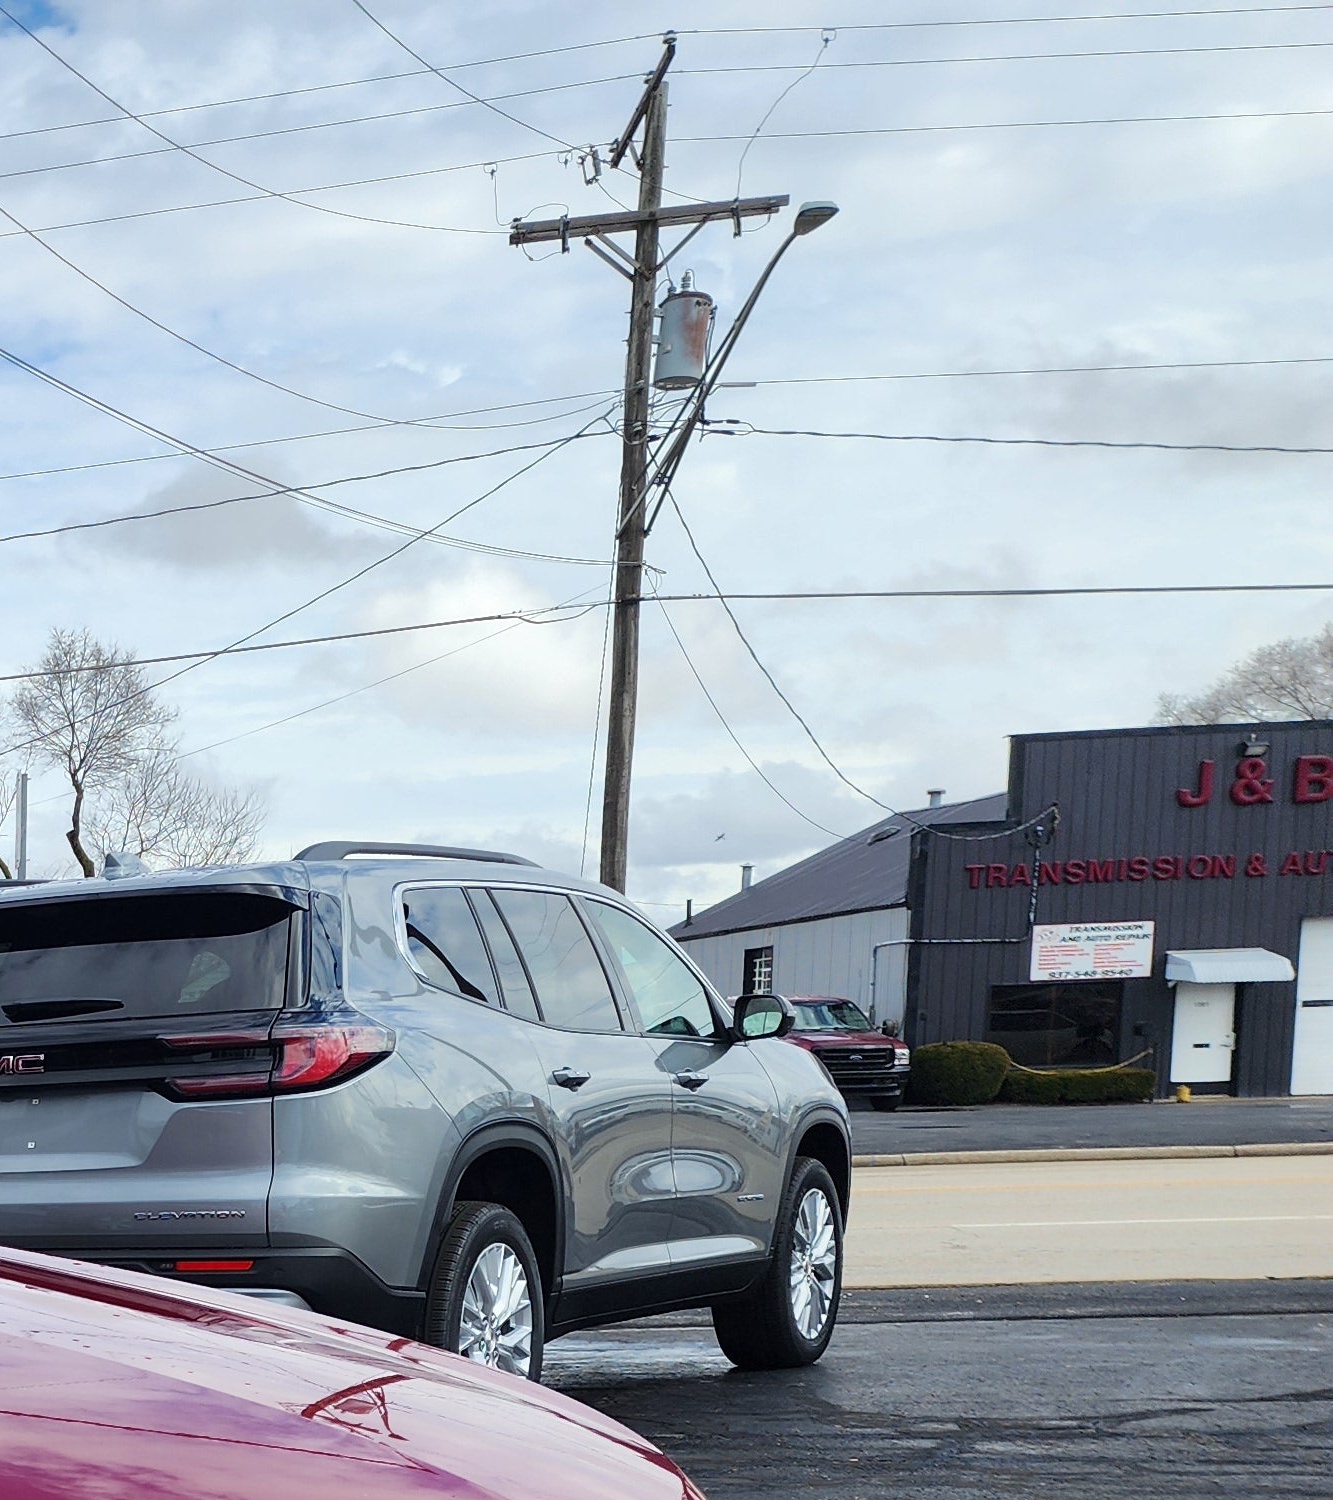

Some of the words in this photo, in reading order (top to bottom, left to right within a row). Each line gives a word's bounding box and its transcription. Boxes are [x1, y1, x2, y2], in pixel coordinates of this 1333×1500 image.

[1176, 759, 1214, 807] J
[1230, 757, 1274, 805] &
[1293, 754, 1333, 803] B
[965, 855, 1236, 889] TRANSMISSION
[1245, 852, 1268, 877] &
[134, 1210, 246, 1220] ELEVATION
